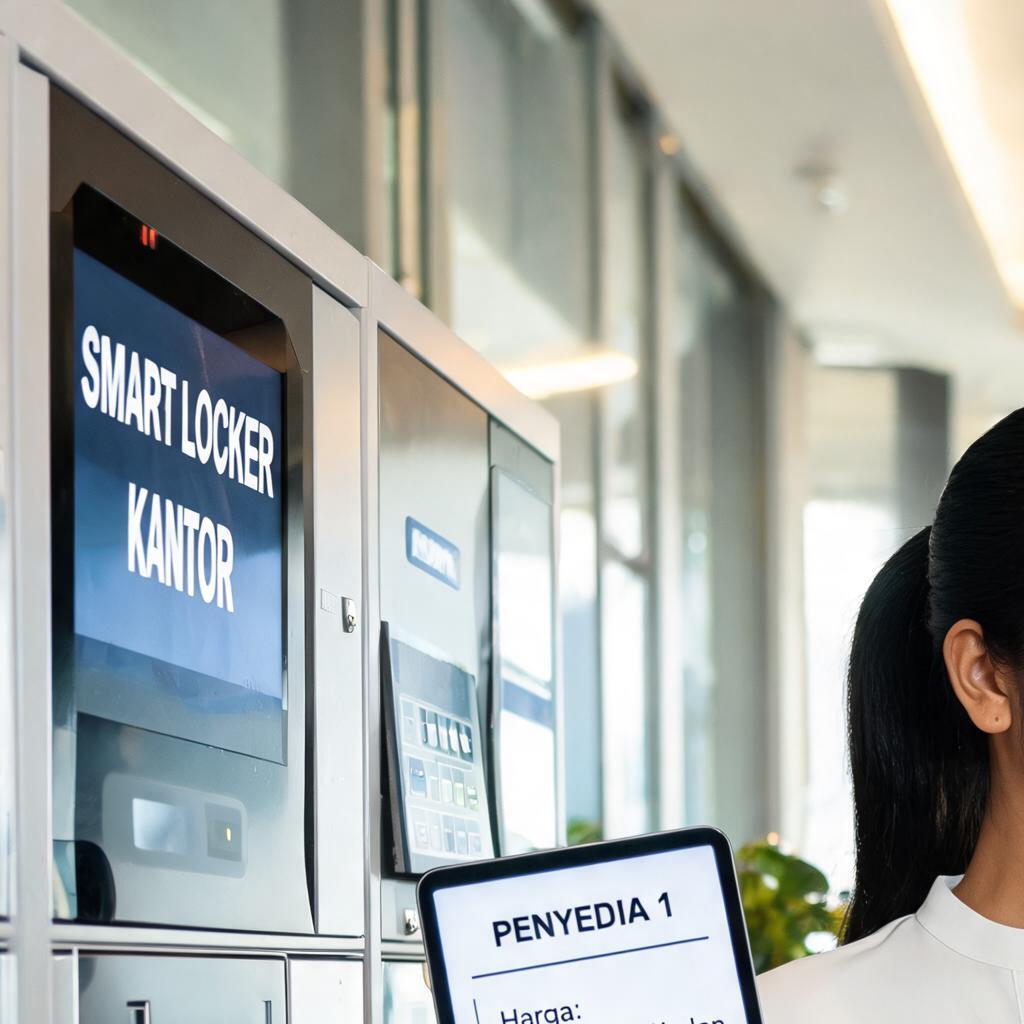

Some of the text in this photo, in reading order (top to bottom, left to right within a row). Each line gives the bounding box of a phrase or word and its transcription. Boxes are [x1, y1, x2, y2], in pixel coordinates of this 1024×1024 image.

[81, 325, 275, 499] SMART LOCKER
[127, 481, 235, 614] KANTOR
[492, 891, 673, 948] PENYEDIA 1
